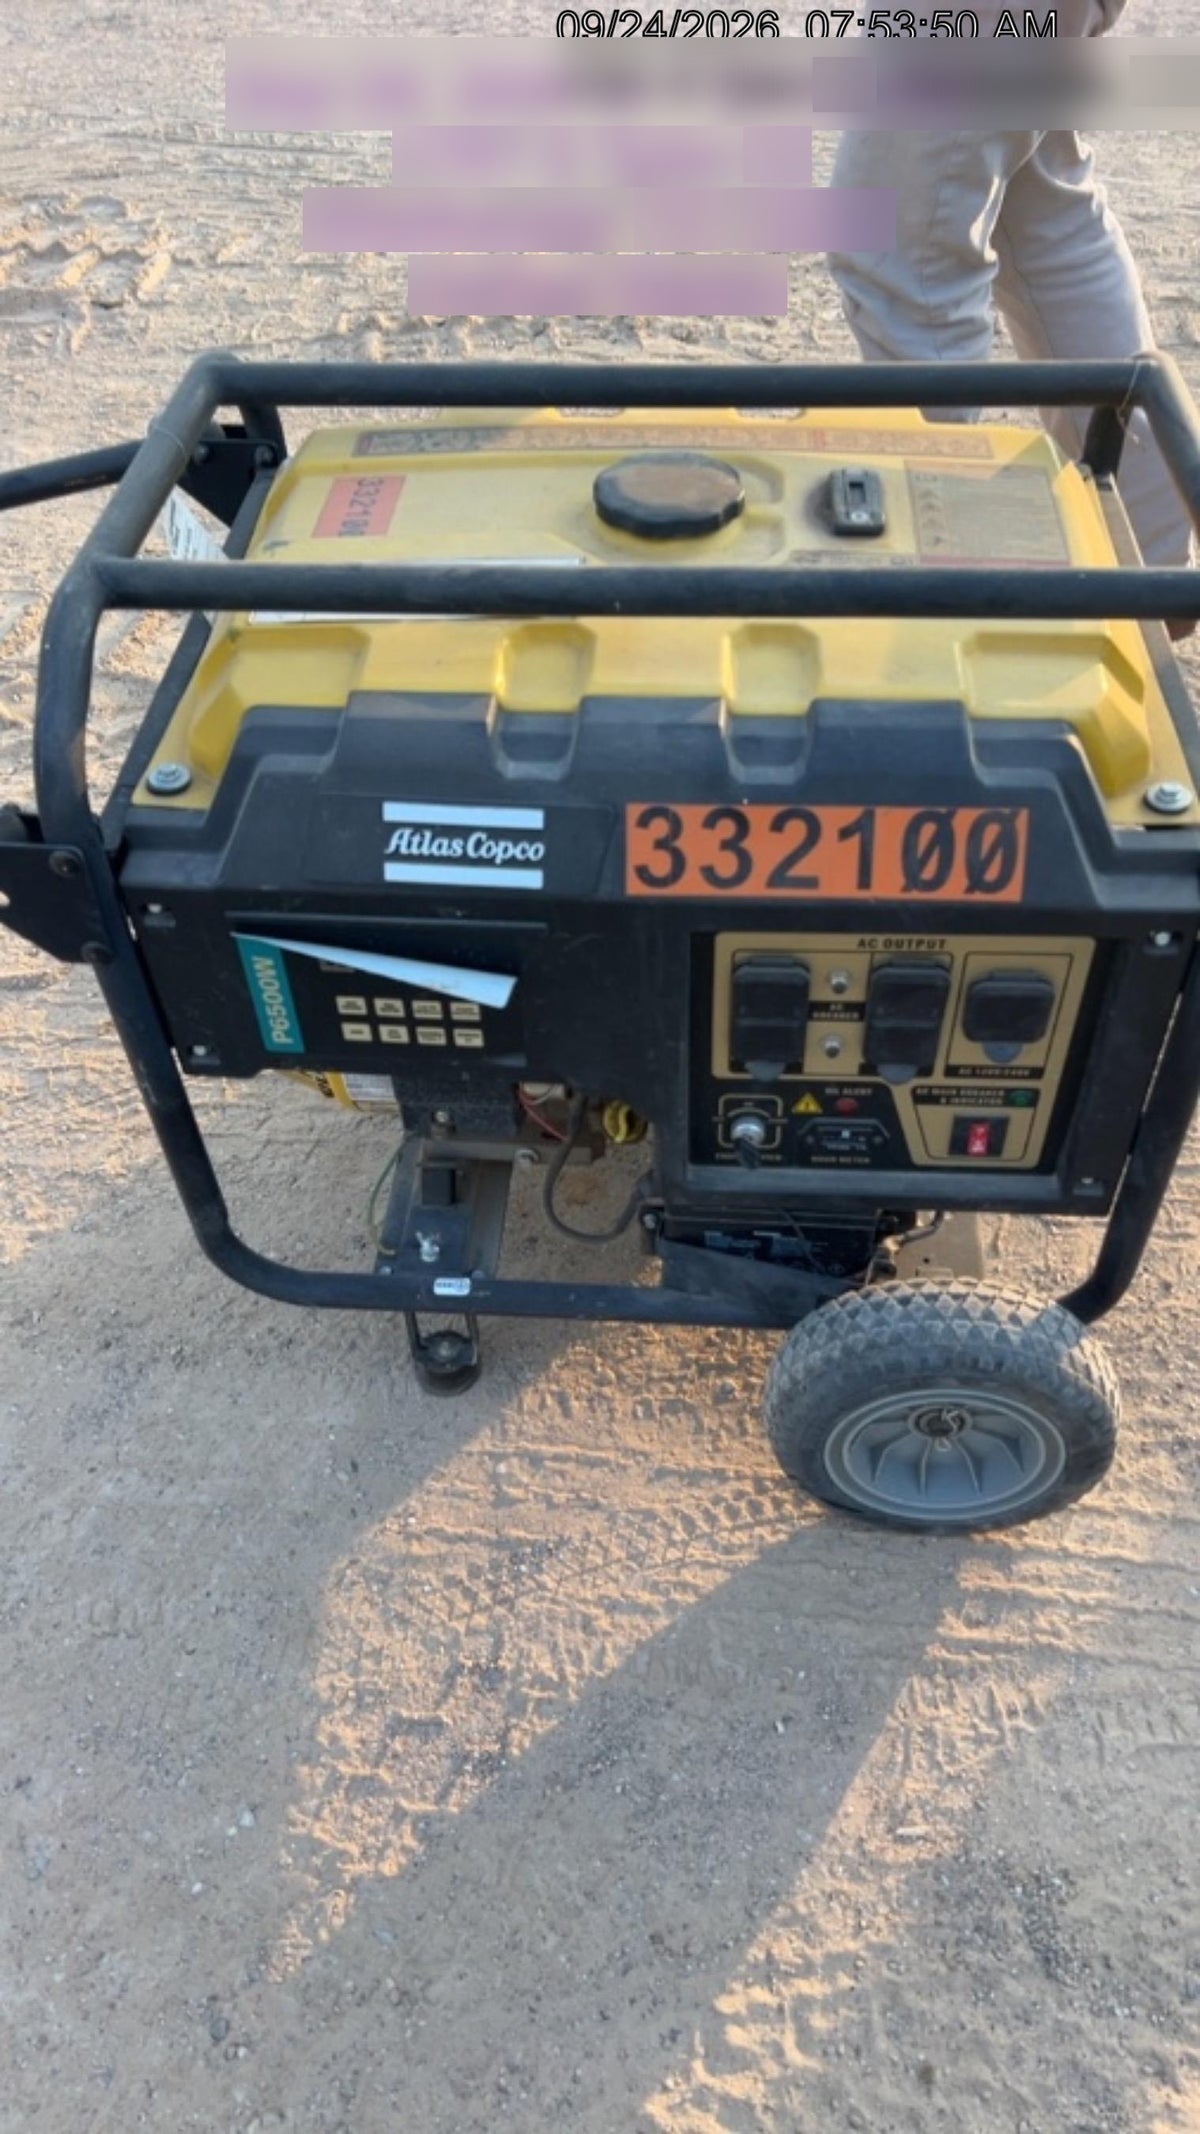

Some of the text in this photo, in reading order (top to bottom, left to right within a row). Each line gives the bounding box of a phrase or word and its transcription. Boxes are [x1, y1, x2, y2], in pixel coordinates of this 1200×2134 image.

[384, 827, 545, 866] Atlas Copco
[857, 938, 947, 950] AC OUTPUT
[250, 955, 295, 1045] P6500W
